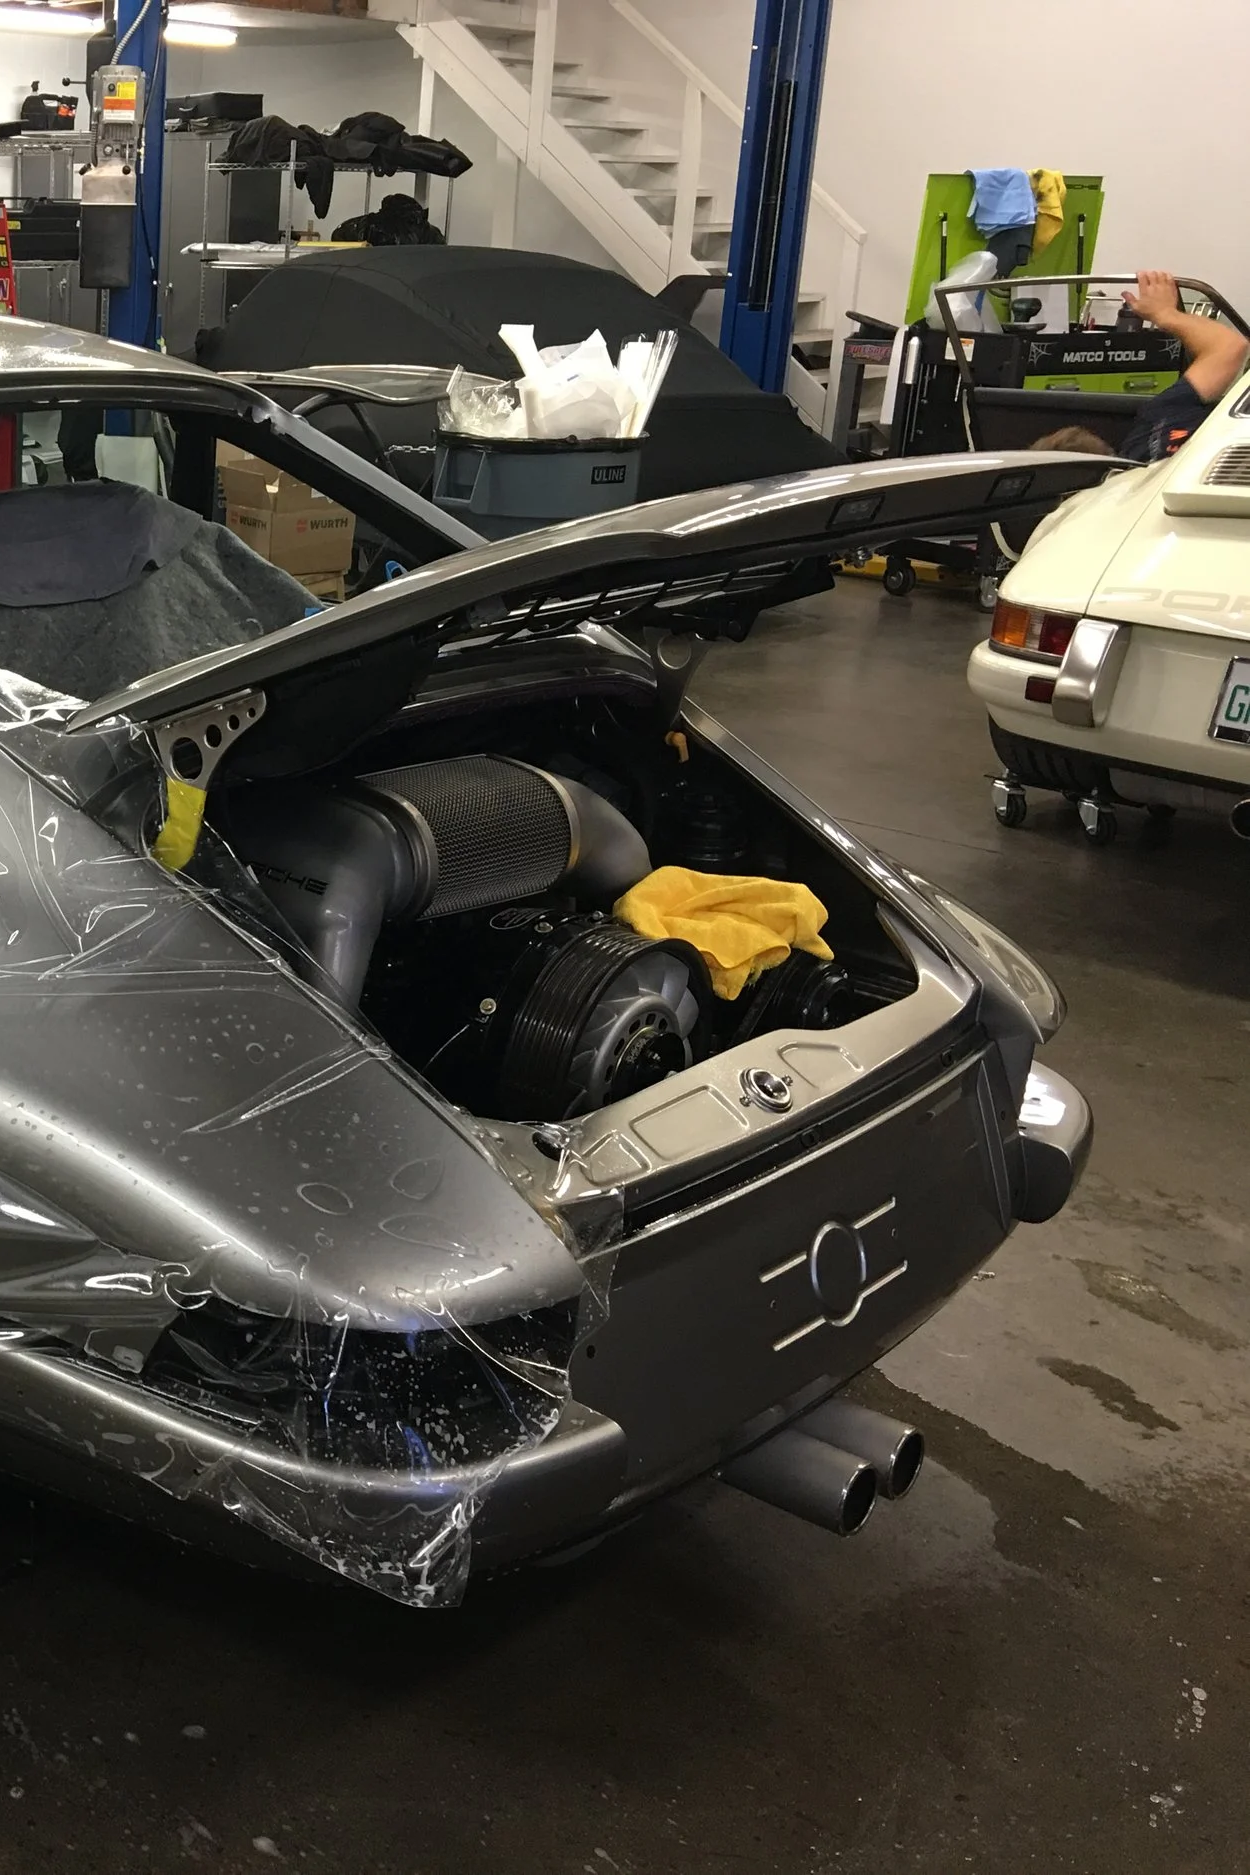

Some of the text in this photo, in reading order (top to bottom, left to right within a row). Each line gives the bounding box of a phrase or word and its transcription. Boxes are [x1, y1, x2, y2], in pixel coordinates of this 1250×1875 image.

[1063, 350, 1146, 363] MATCO TOOLS
[594, 468, 625, 481] ULINE
[310, 517, 349, 530] WURTH
